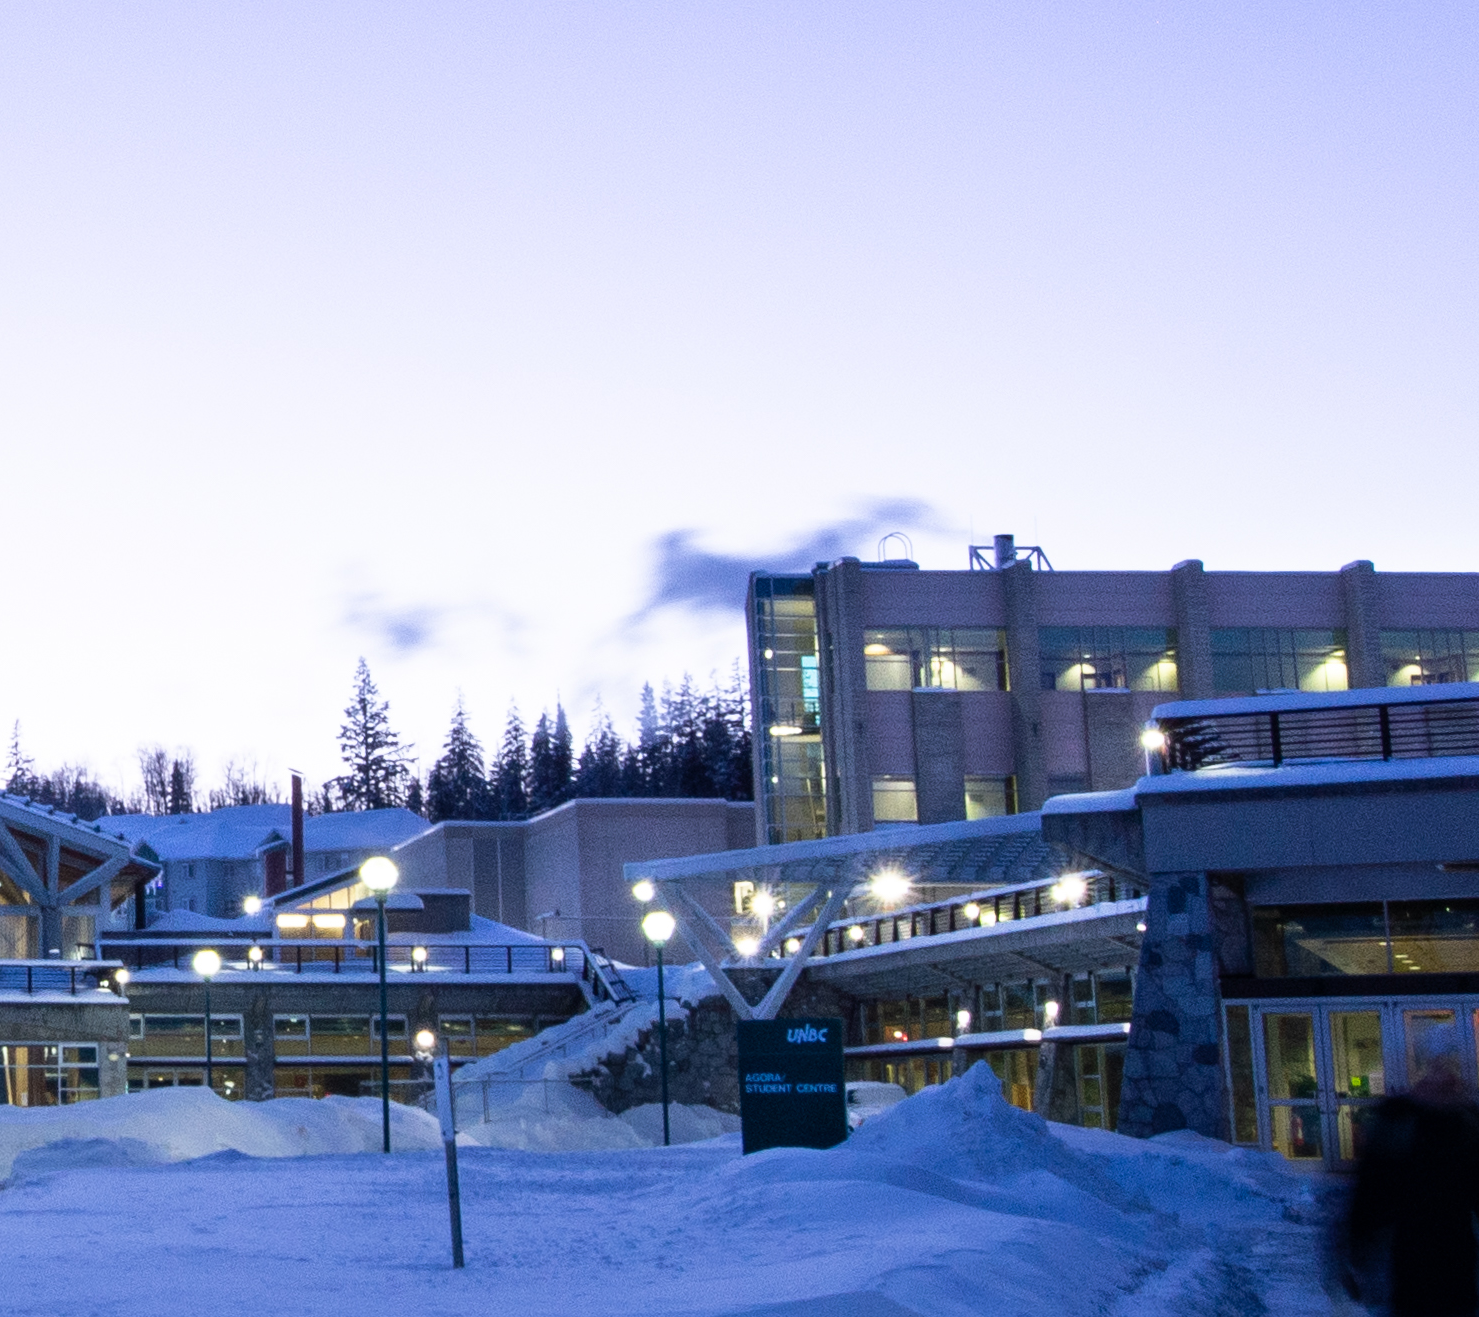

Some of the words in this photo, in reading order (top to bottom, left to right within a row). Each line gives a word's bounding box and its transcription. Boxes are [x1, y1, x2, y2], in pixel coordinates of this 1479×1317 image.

[786, 1024, 829, 1044] UNBC
[745, 1084, 792, 1093] STUDENT
[796, 1084, 838, 1093] CENTRE
